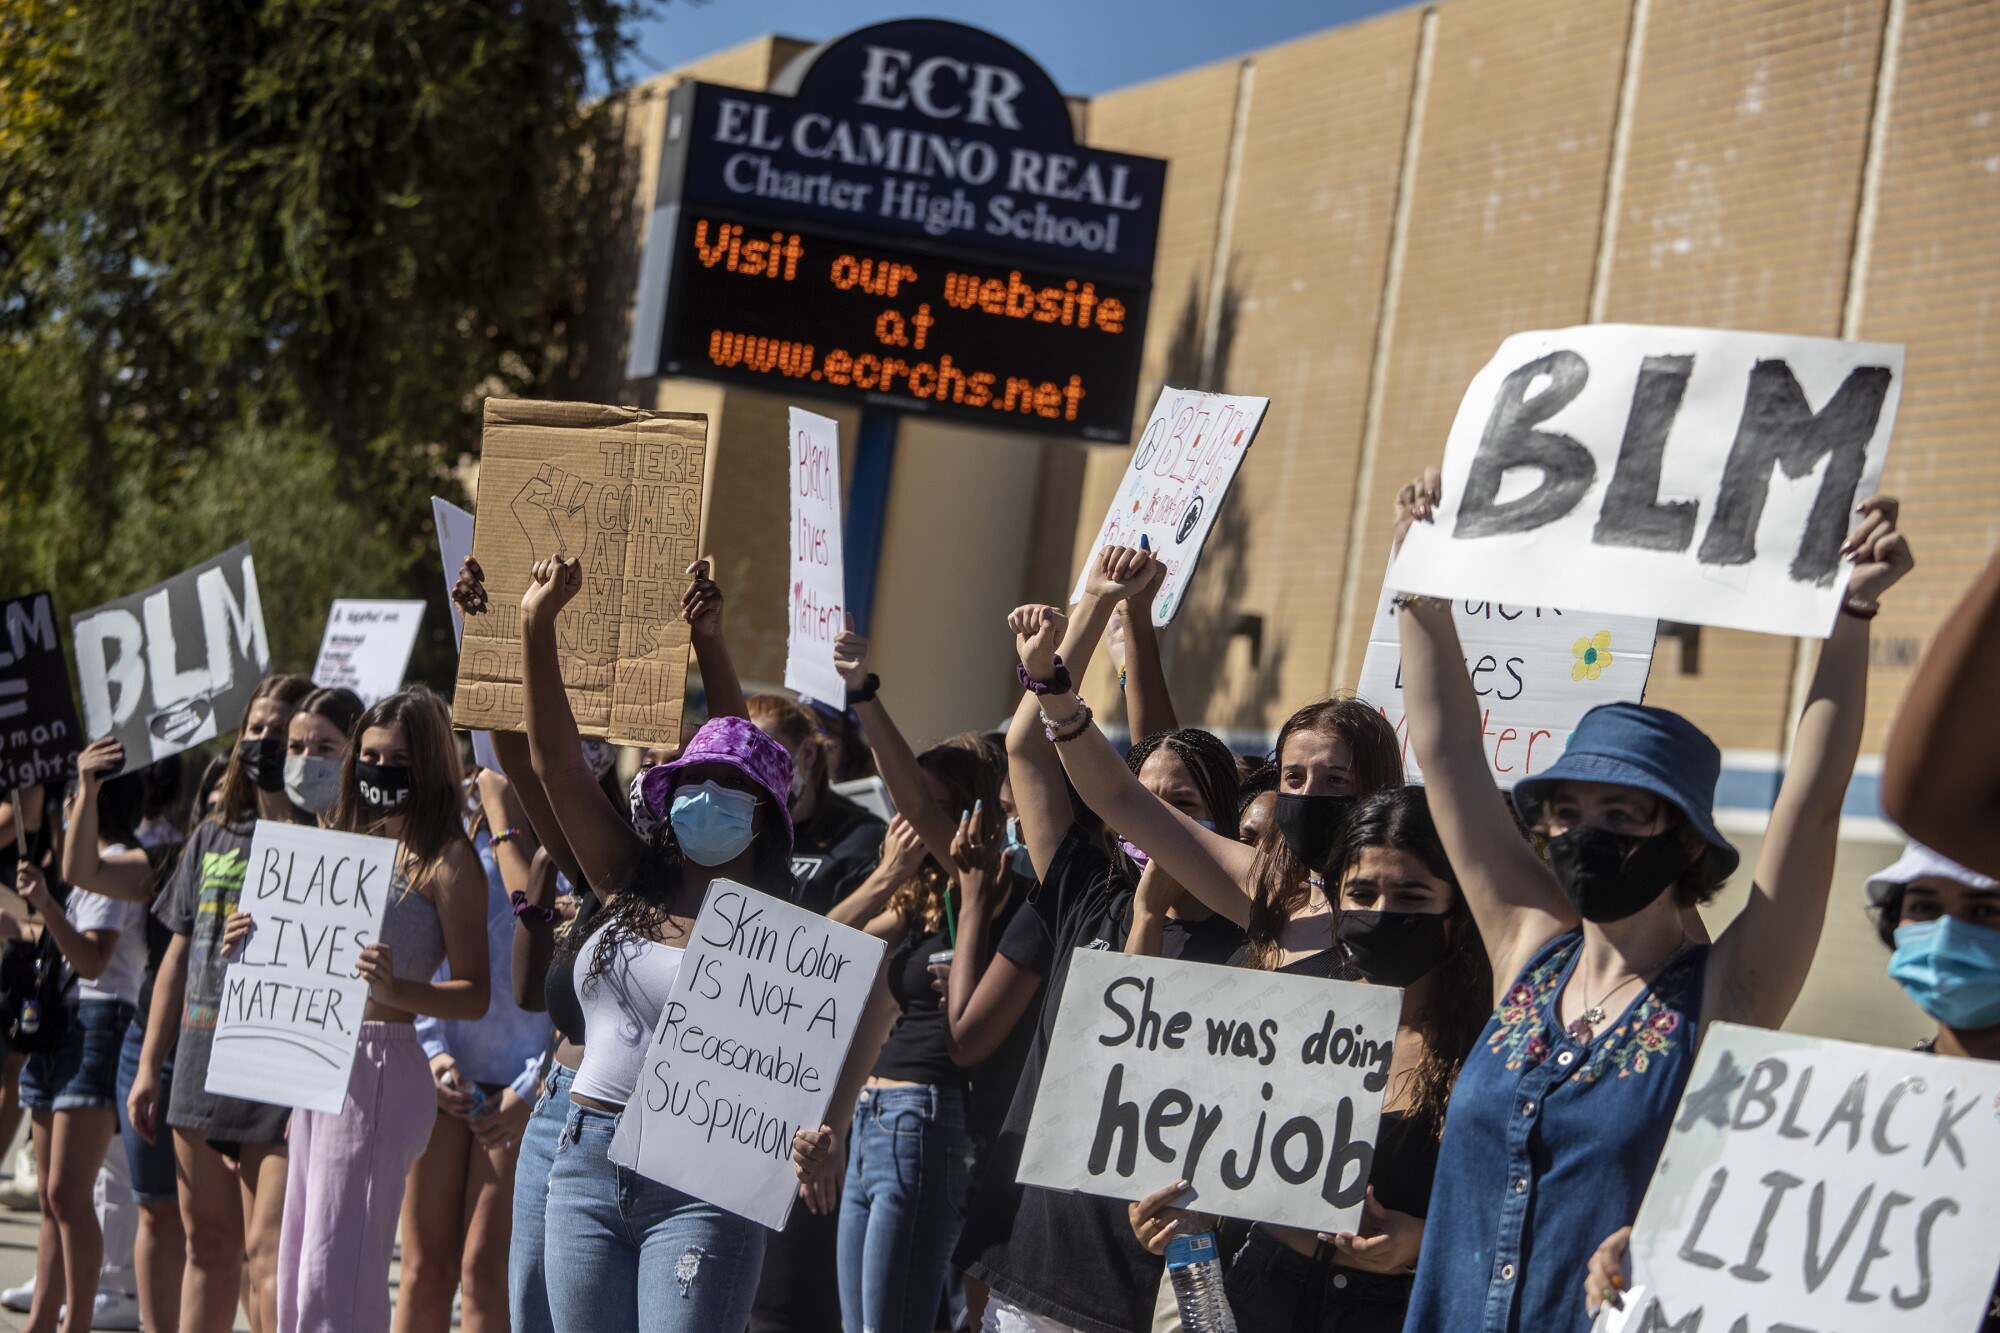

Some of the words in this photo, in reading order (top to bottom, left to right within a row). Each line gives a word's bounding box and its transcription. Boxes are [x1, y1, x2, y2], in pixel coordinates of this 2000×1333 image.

[858, 44, 1025, 131] ECR
[712, 100, 784, 150] EL
[792, 113, 999, 185] CAMINO
[1007, 148, 1142, 210] REAL
[723, 152, 873, 213] Charter
[879, 178, 977, 235] High
[985, 195, 1121, 254] School
[694, 219, 803, 281] Visit
[830, 254, 918, 298] our
[944, 270, 1126, 333] website
[875, 303, 934, 350] at
[708, 329, 1087, 421] www.ecrchs.net
[600, 441, 703, 485] THERE
[798, 430, 832, 510] Black
[1154, 405, 1243, 486] BLM
[1453, 349, 1891, 588] BLM
[597, 484, 697, 536] COMES
[589, 532, 609, 575] A
[610, 533, 696, 581] TIME
[476, 602, 621, 655] SILNCE
[628, 614, 662, 659] IS
[588, 577, 688, 622] WHEN
[75, 554, 270, 741] BLM
[467, 650, 679, 727] BERAYAL
[0, 720, 67, 748] man
[257, 847, 378, 917] BLACK
[241, 916, 369, 980] LIVES
[786, 925, 852, 983] Color
[225, 977, 351, 1035] MATTER.
[807, 998, 836, 1039] A
[1099, 976, 1192, 1051] She
[1206, 1018, 1278, 1066] was
[1301, 1009, 1393, 1092] doing
[658, 1002, 822, 1092] Reasonable
[1087, 1063, 1223, 1187] her
[1220, 1082, 1375, 1209] job
[1731, 1057, 1982, 1169] BLACK
[1677, 1166, 1960, 1310] LIVES
